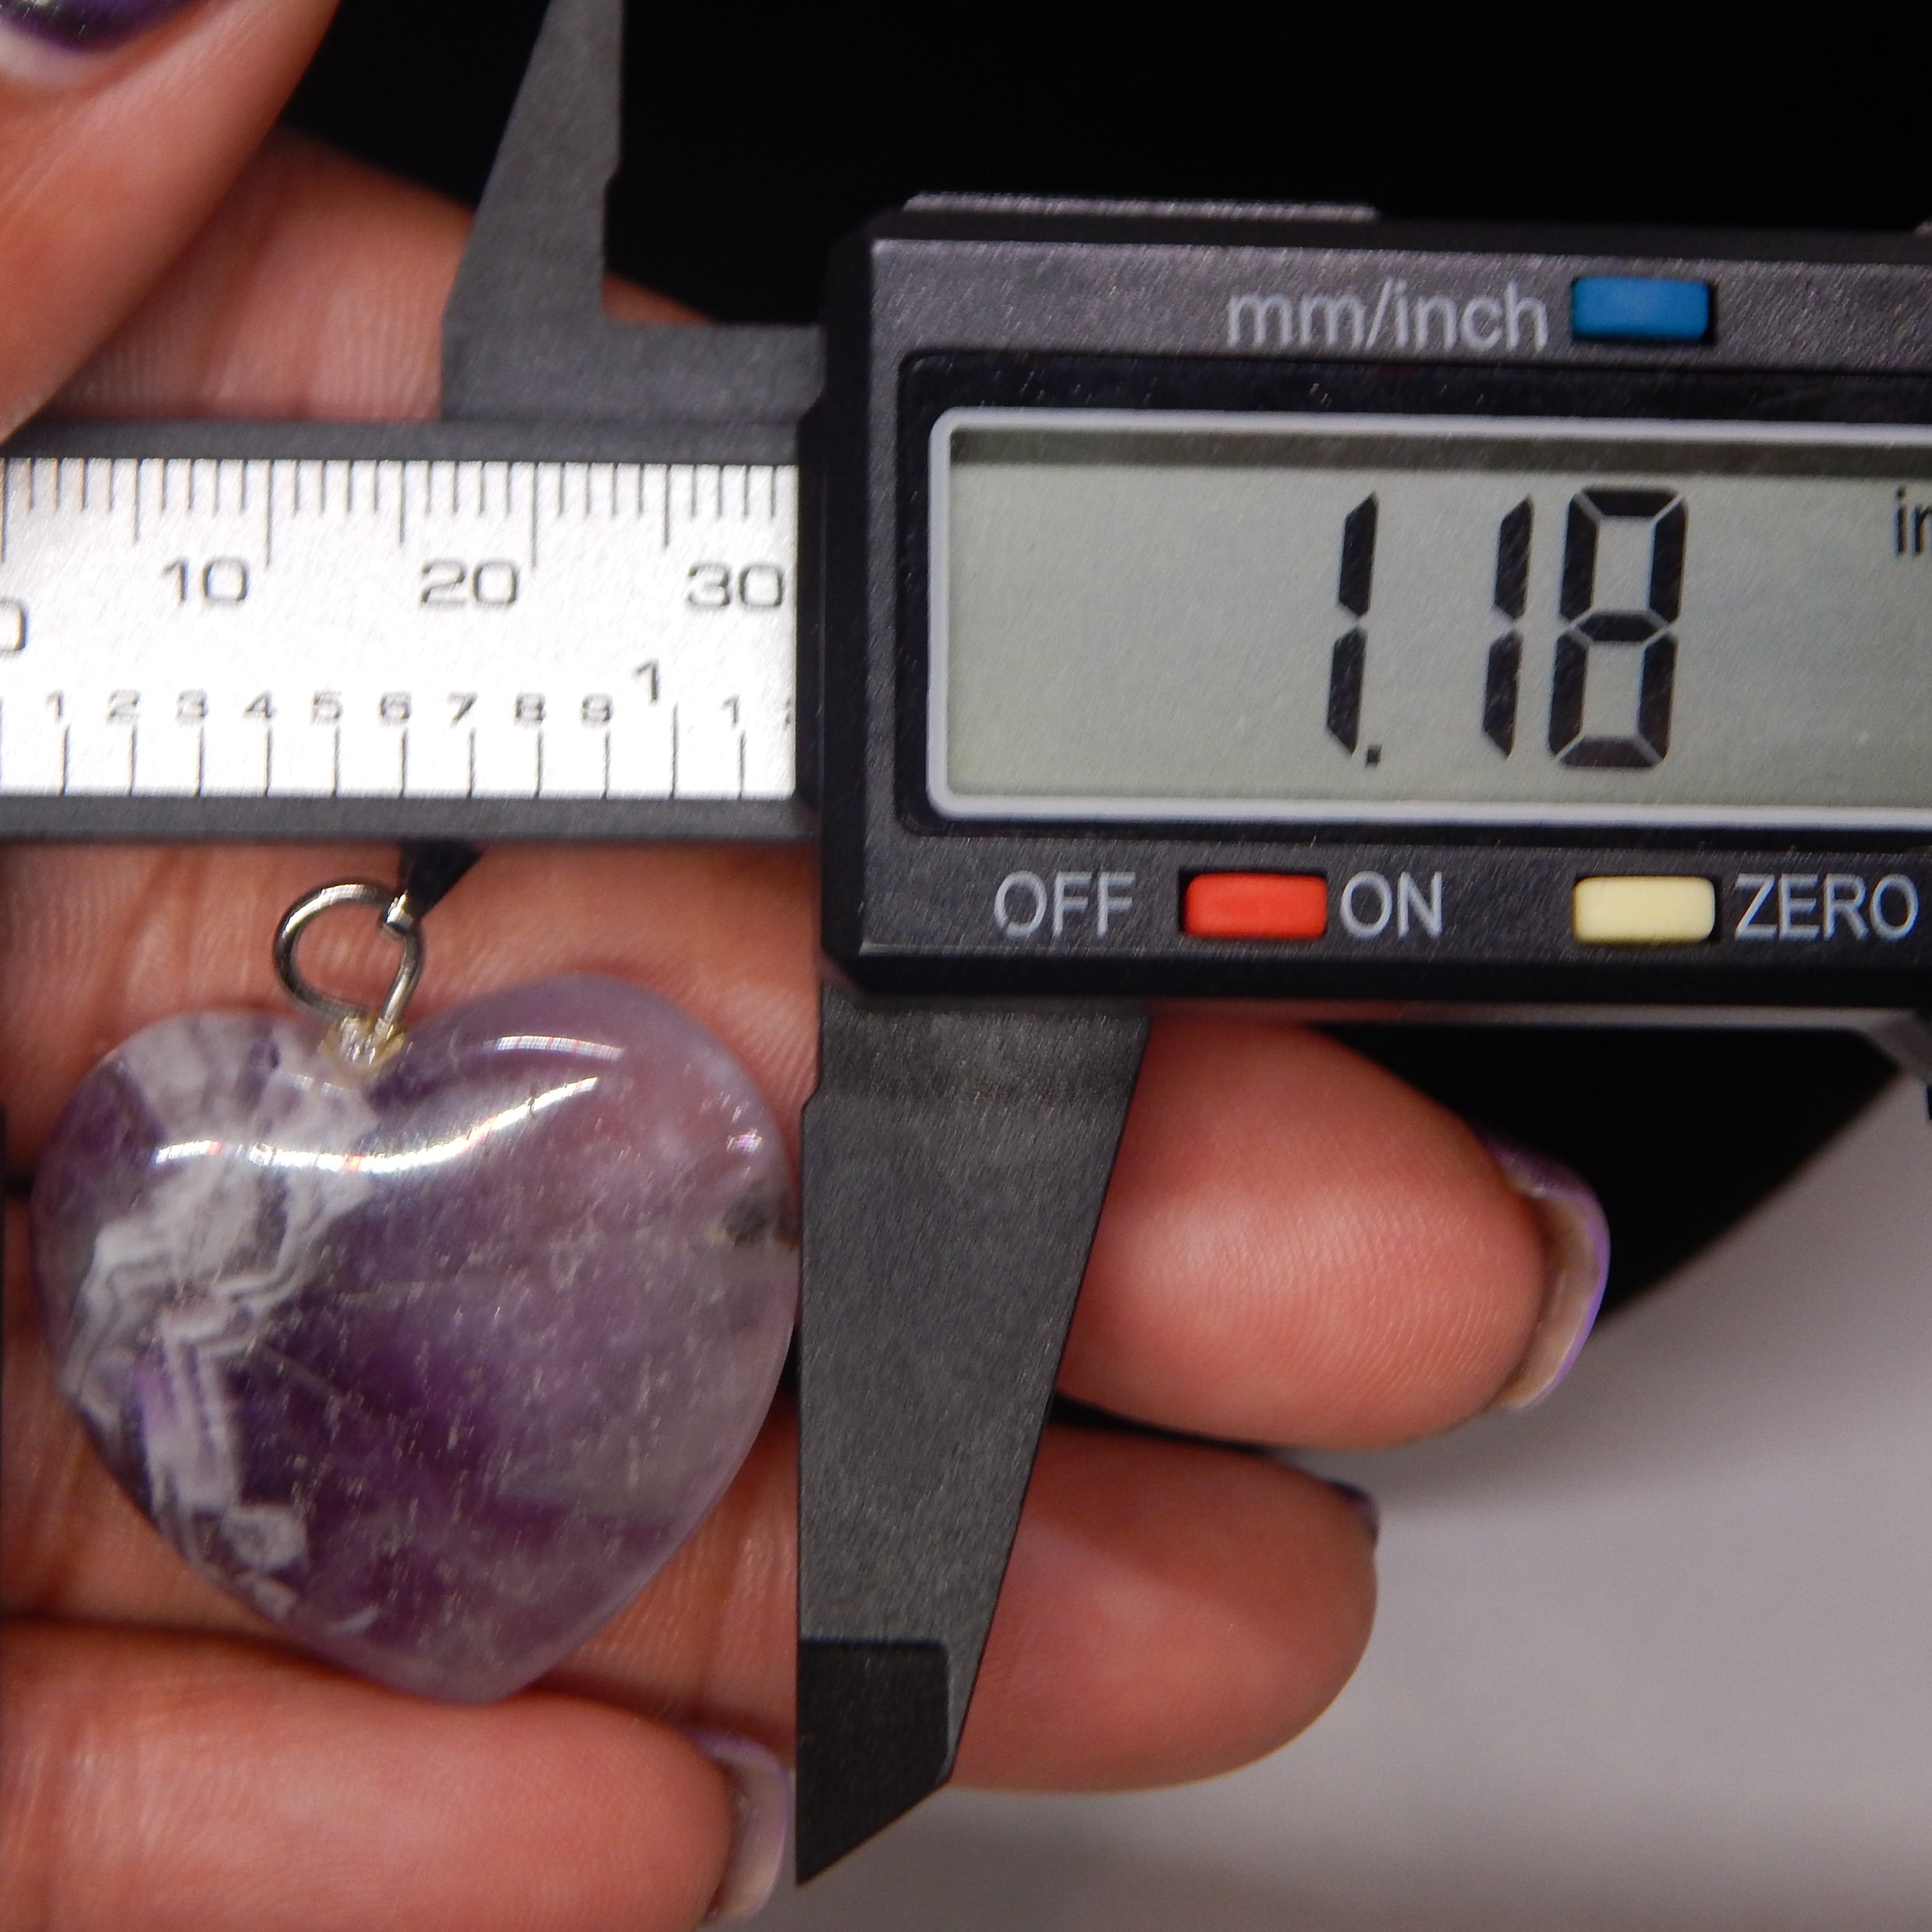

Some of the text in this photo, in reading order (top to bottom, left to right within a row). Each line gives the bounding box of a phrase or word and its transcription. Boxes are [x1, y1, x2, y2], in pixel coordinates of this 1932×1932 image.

[1226, 278, 1550, 350] mm/inch
[162, 556, 784, 609] 10 20 30
[1325, 484, 1689, 771] 1.18
[46, 690, 65, 723] 1
[108, 690, 140, 723] 2
[176, 690, 208, 724] 3
[243, 690, 275, 719] 4
[310, 691, 342, 725] 5
[448, 692, 477, 728] 7
[514, 692, 545, 726] 8
[721, 695, 740, 728] 1
[633, 659, 660, 703] 1
[993, 871, 1136, 938] OFF
[1339, 871, 1444, 938] ON
[1734, 873, 1919, 938] ZERO
